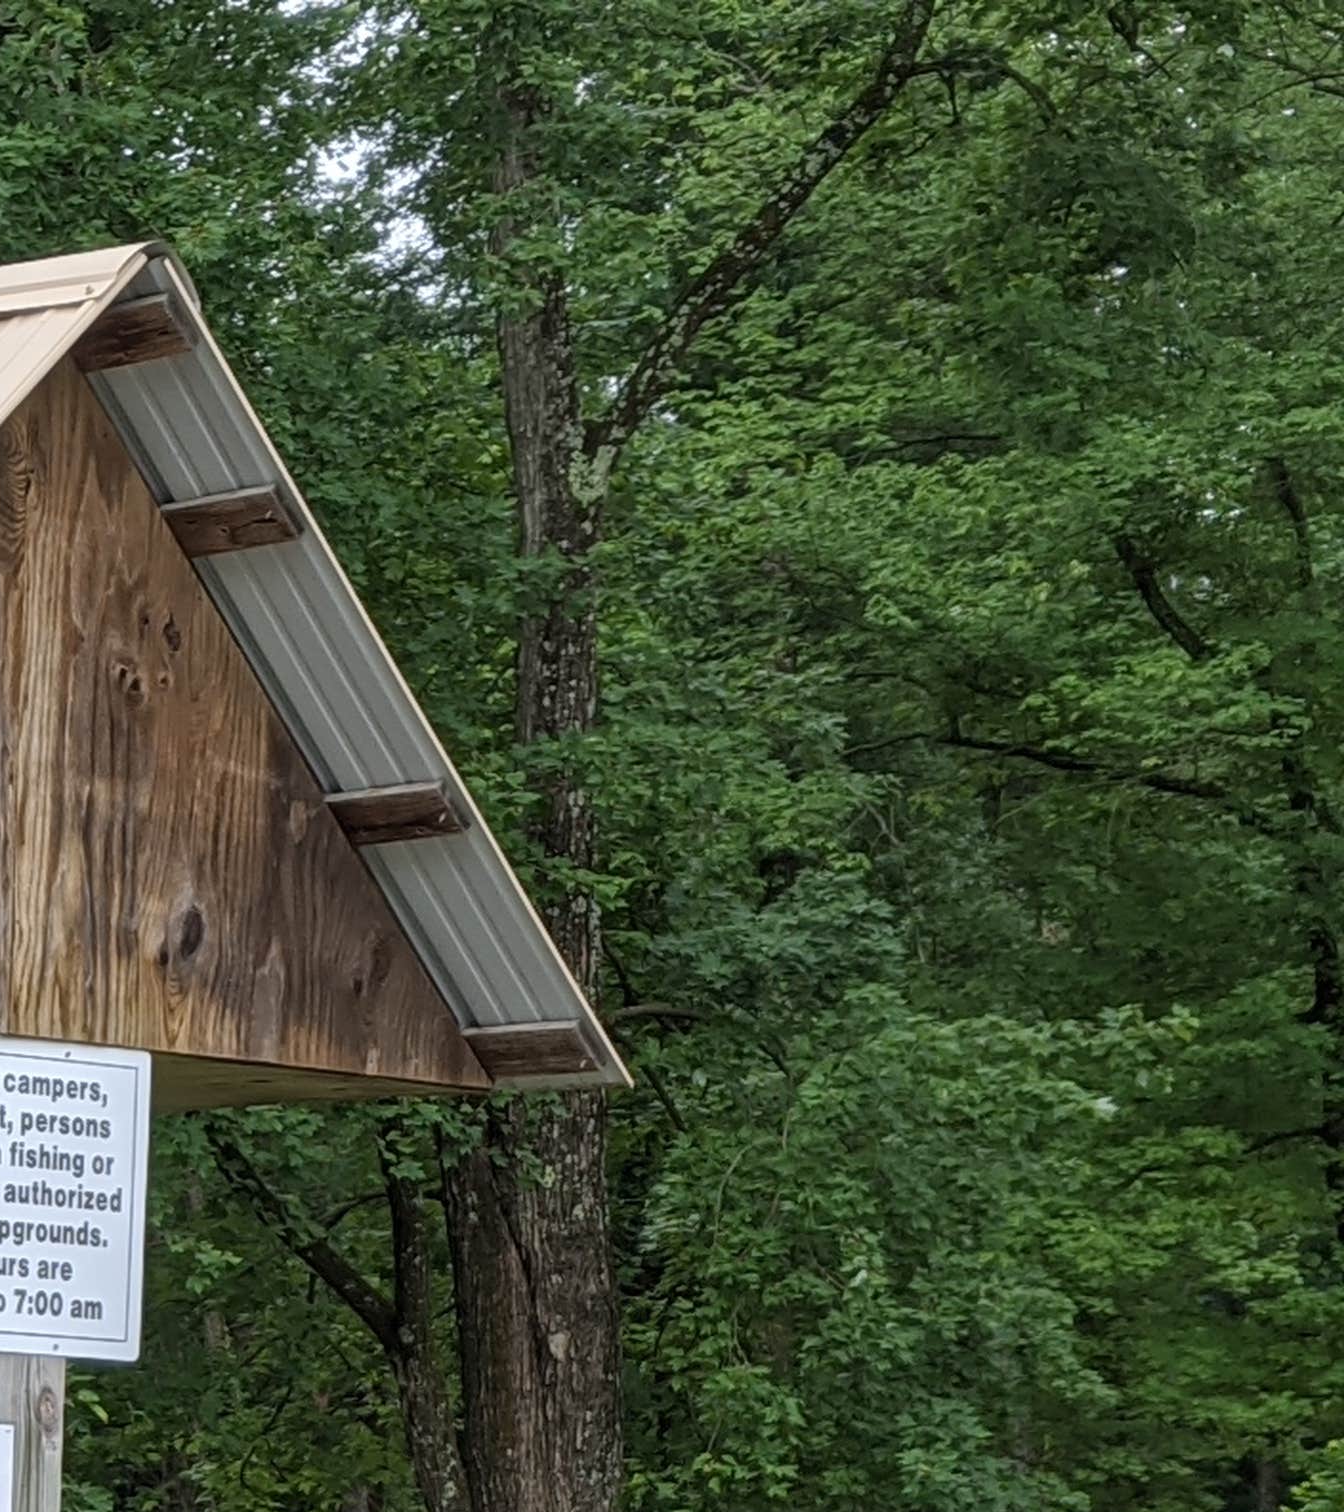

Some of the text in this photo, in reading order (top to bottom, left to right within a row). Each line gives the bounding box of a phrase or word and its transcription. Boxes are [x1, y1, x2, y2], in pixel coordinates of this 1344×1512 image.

[3, 1072, 108, 1107] campers,
[20, 1110, 111, 1139] persons
[9, 1141, 86, 1177] fishing
[92, 1153, 114, 1175] or
[4, 1180, 123, 1213] authorized
[37, 1259, 74, 1281] are
[14, 1289, 63, 1317] 7:00
[70, 1298, 103, 1320] am
